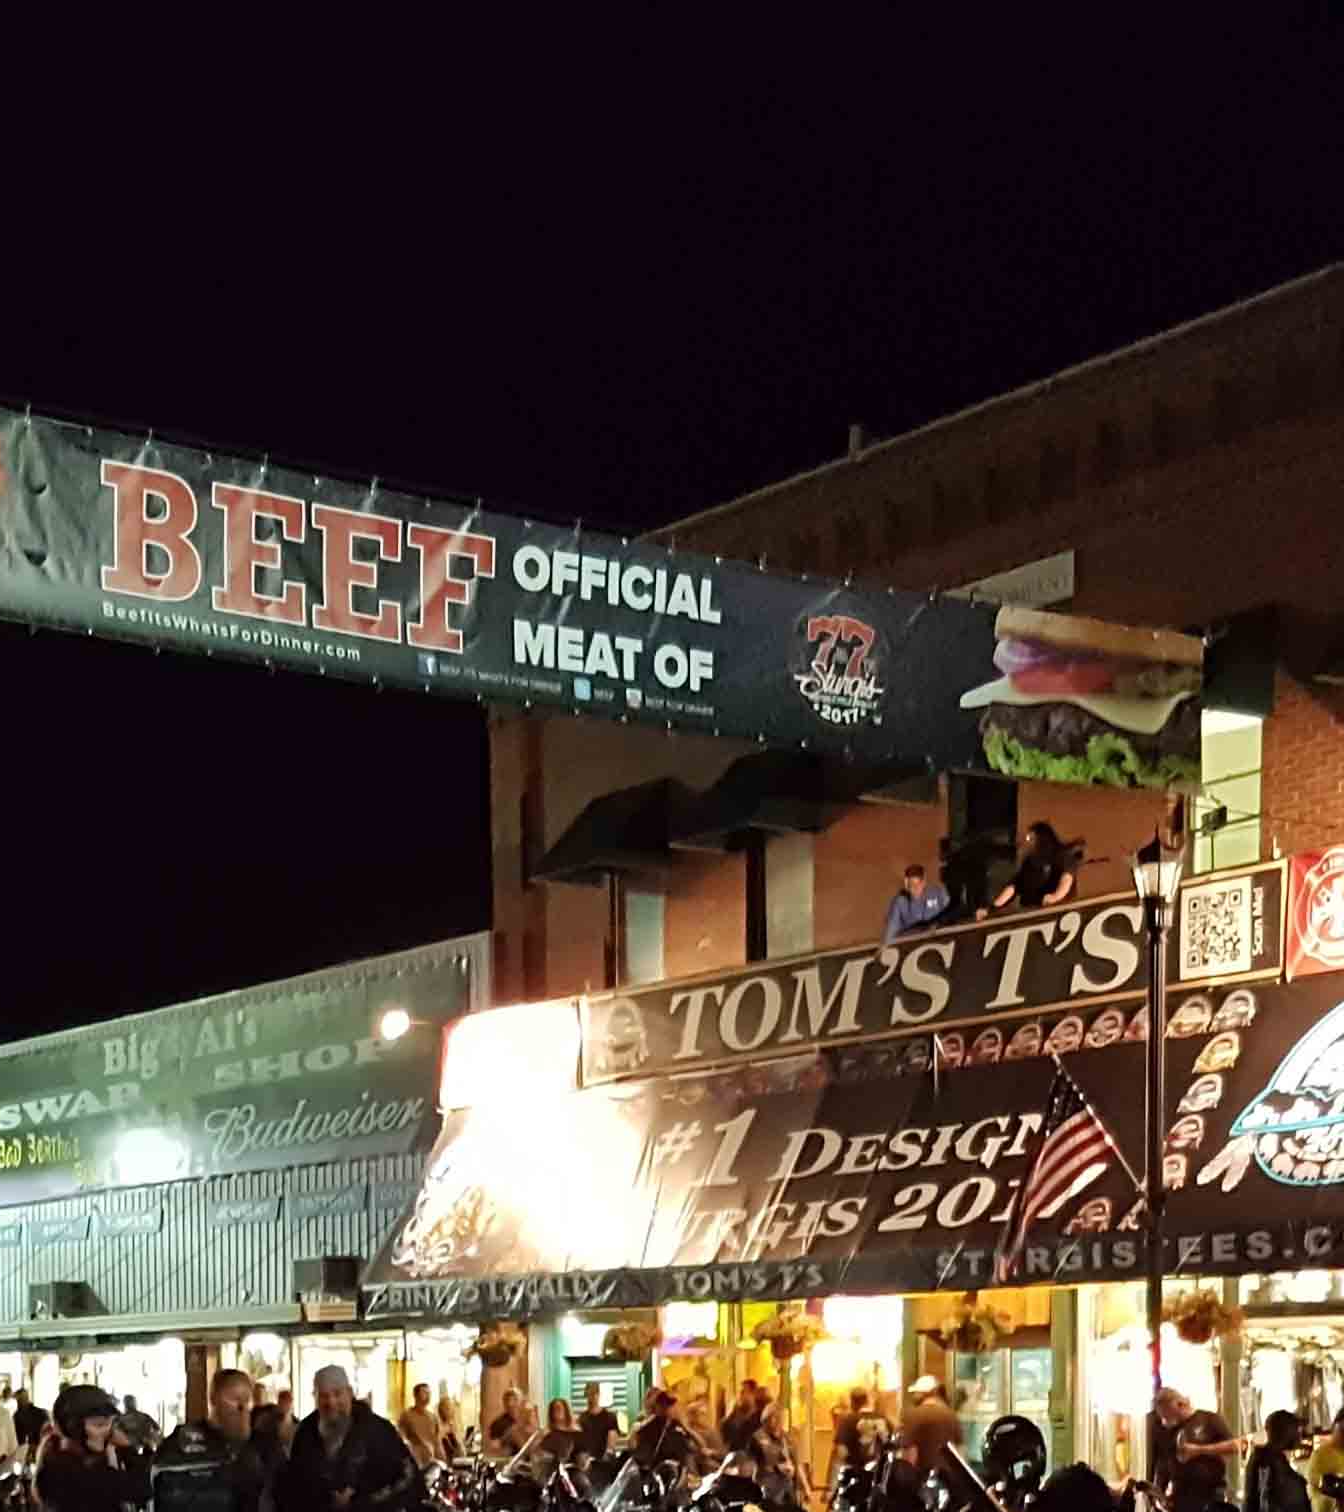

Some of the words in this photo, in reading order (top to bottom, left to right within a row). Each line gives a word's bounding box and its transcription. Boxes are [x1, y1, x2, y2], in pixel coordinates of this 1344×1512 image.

[100, 458, 496, 655] BEEF
[512, 545, 722, 626] OFFICIAL
[513, 619, 643, 682] MEAT
[652, 643, 714, 693] OF
[668, 940, 956, 1060] TOM'S
[982, 904, 1144, 1011] T'S
[103, 1032, 162, 1079] Big
[203, 1090, 425, 1165] Budweiser
[657, 1108, 757, 1187] #1
[680, 1196, 870, 1254] URGIS
[877, 1176, 1023, 1234] 201
[672, 1265, 768, 1298] TOM'S
